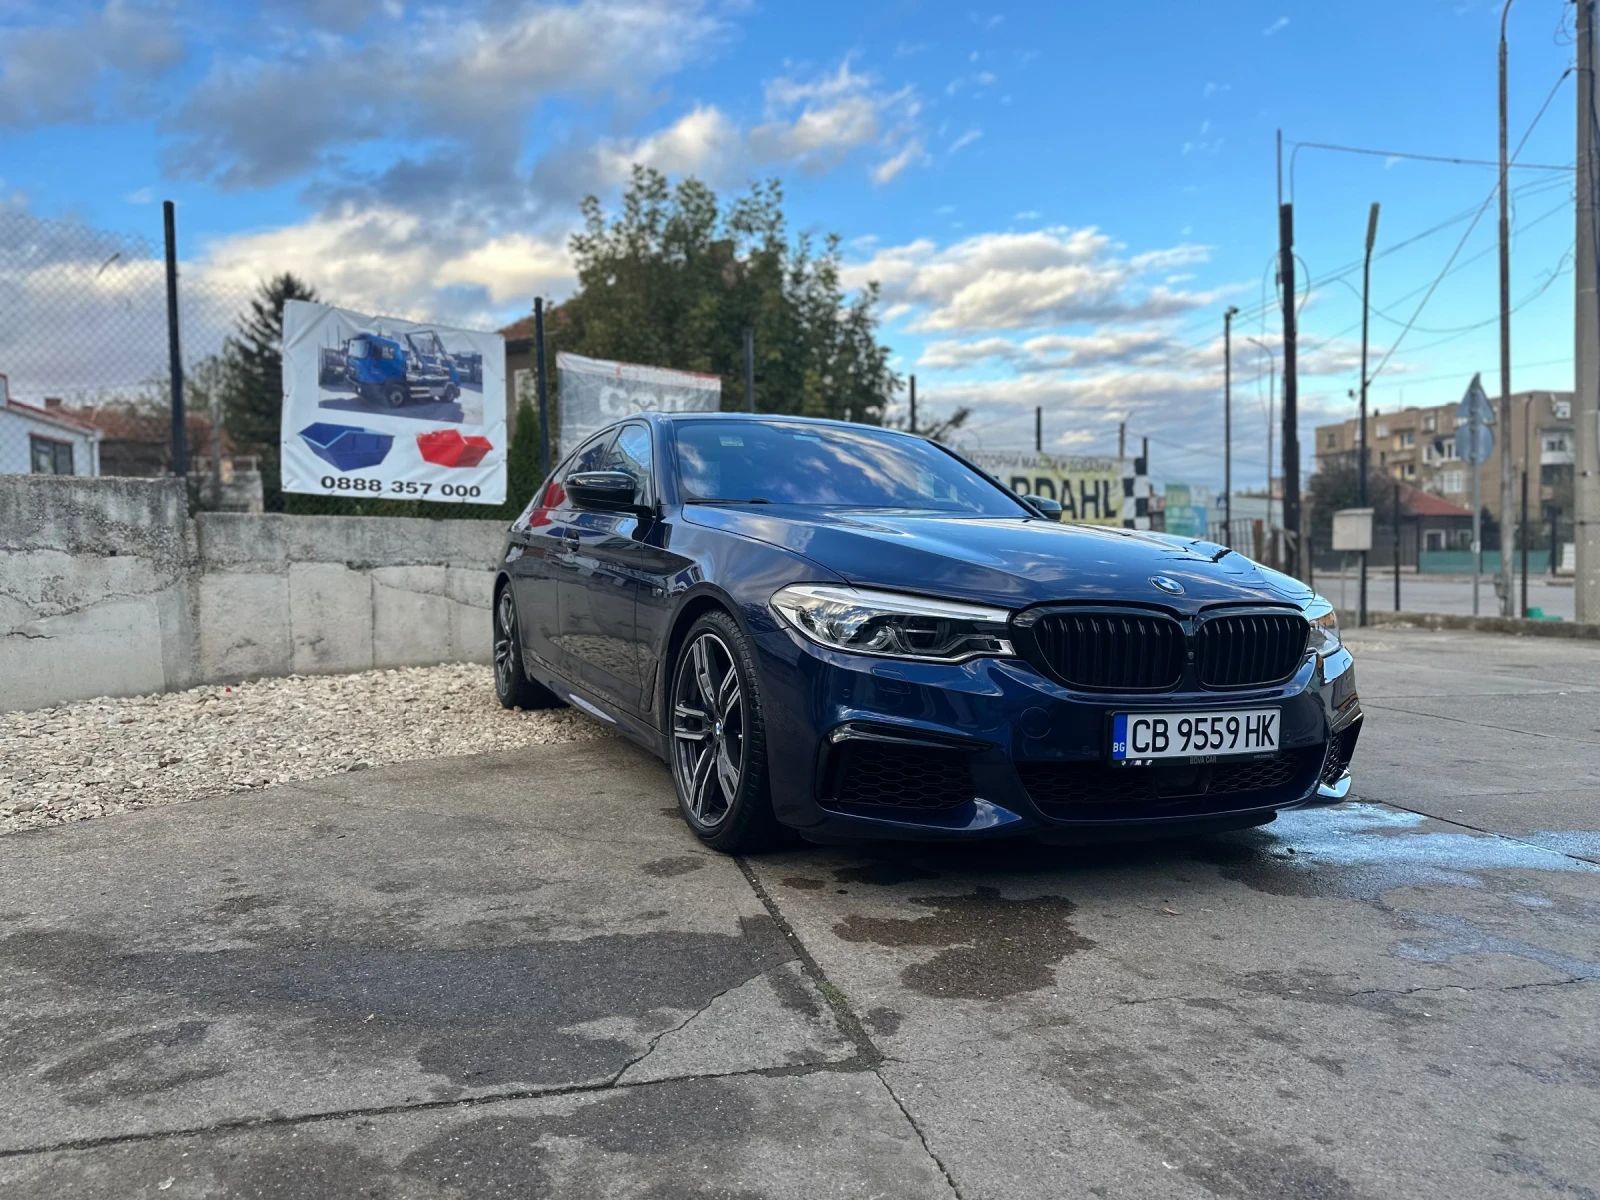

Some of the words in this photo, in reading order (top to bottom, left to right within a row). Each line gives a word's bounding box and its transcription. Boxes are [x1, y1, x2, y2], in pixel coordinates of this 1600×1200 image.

[320, 475, 382, 492] 0888
[391, 480, 433, 495] 357
[441, 484, 481, 498] 000
[1131, 718, 1170, 753] CB
[1177, 716, 1240, 752] 9559
[1245, 714, 1276, 748] HK
[1112, 742, 1126, 753] BG
[1205, 755, 1217, 764] CAR
